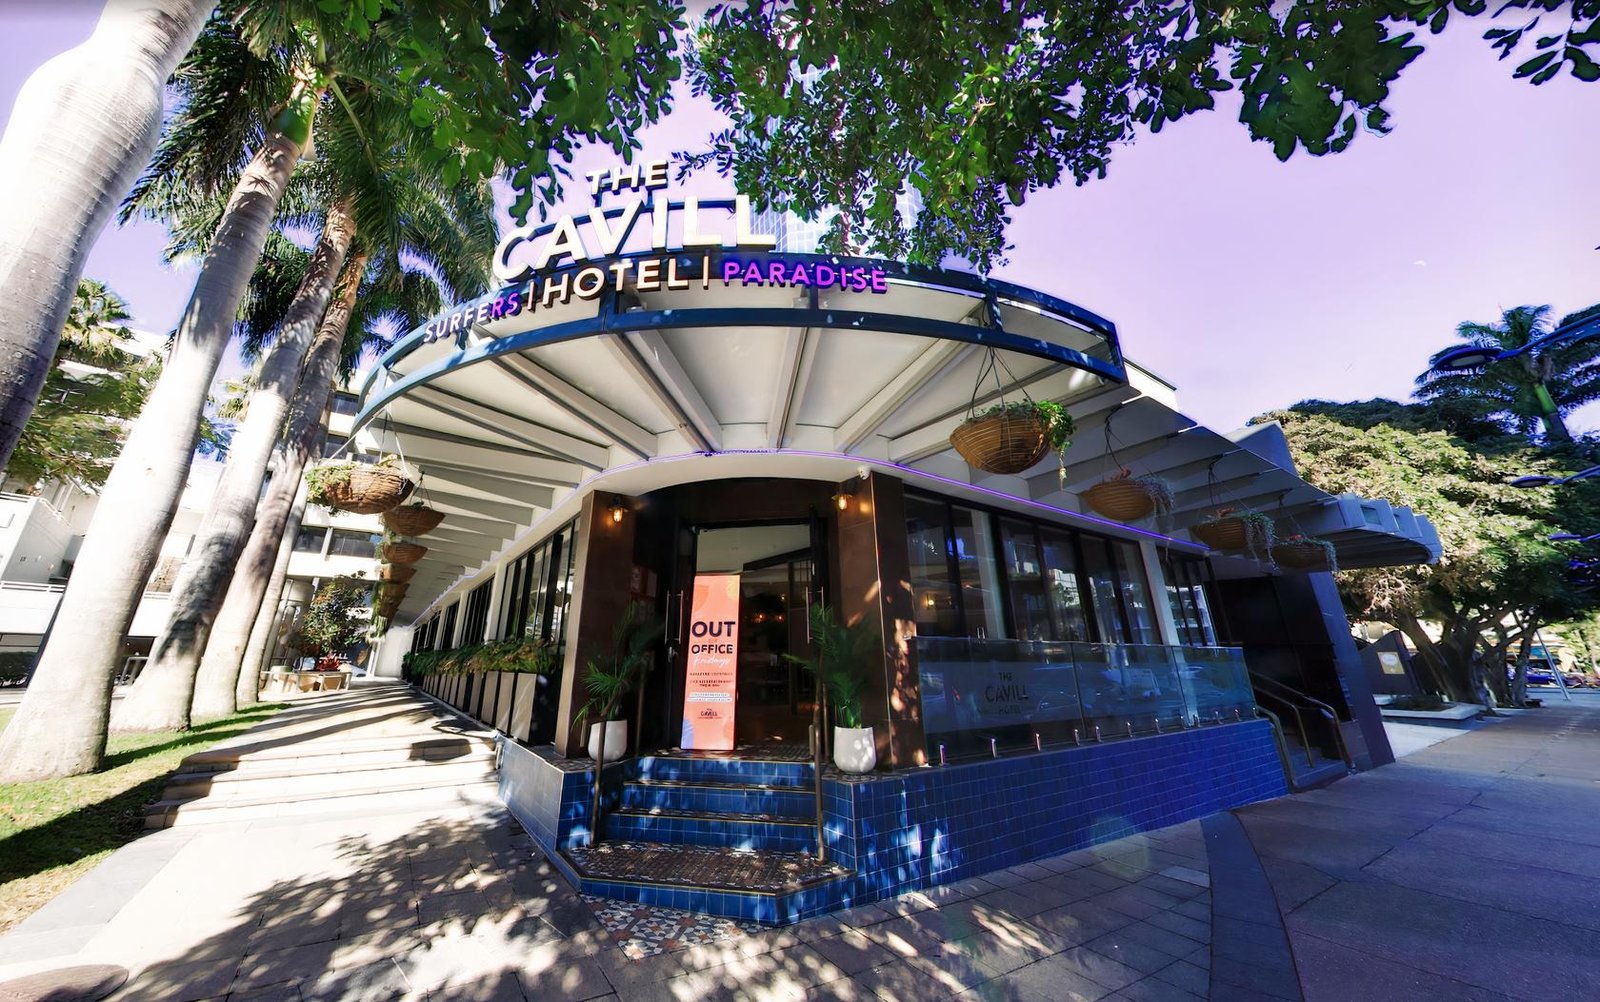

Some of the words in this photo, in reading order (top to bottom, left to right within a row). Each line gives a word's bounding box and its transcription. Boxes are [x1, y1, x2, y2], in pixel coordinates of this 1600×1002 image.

[585, 159, 669, 195] THE
[492, 194, 777, 282] CAVILL
[423, 292, 520, 343] SURFERS
[542, 258, 689, 304] HOTEL
[722, 261, 888, 293] PARADISE
[691, 621, 735, 637] OUT
[691, 644, 733, 654] OFFICE
[999, 672, 1013, 681] THE
[985, 685, 1029, 703] CAVILL
